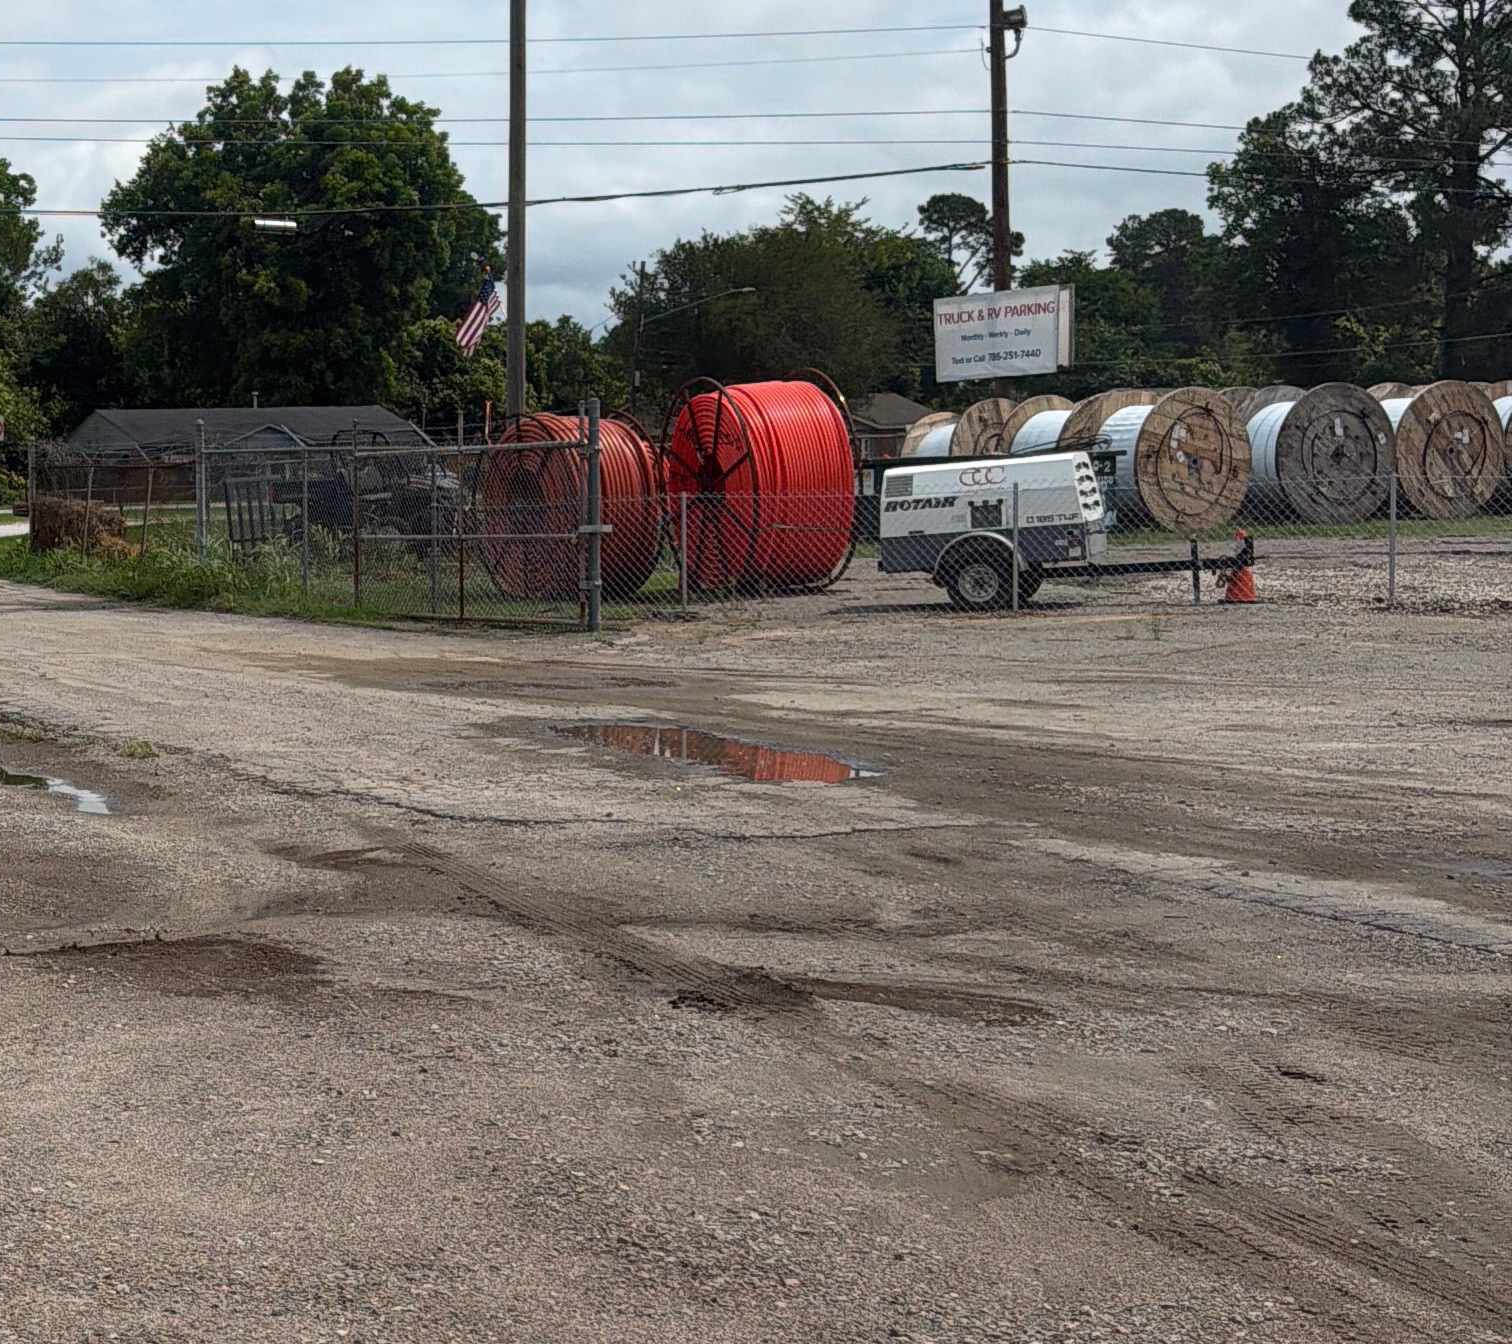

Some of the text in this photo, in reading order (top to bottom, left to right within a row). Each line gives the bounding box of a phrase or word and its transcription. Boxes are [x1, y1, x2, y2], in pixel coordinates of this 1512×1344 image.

[938, 301, 1056, 326] TRUCK & RV PARKING
[1014, 328, 1031, 337] Daily
[951, 357, 965, 365] Text
[974, 354, 986, 363] Call
[884, 496, 961, 513] ROTAIR
